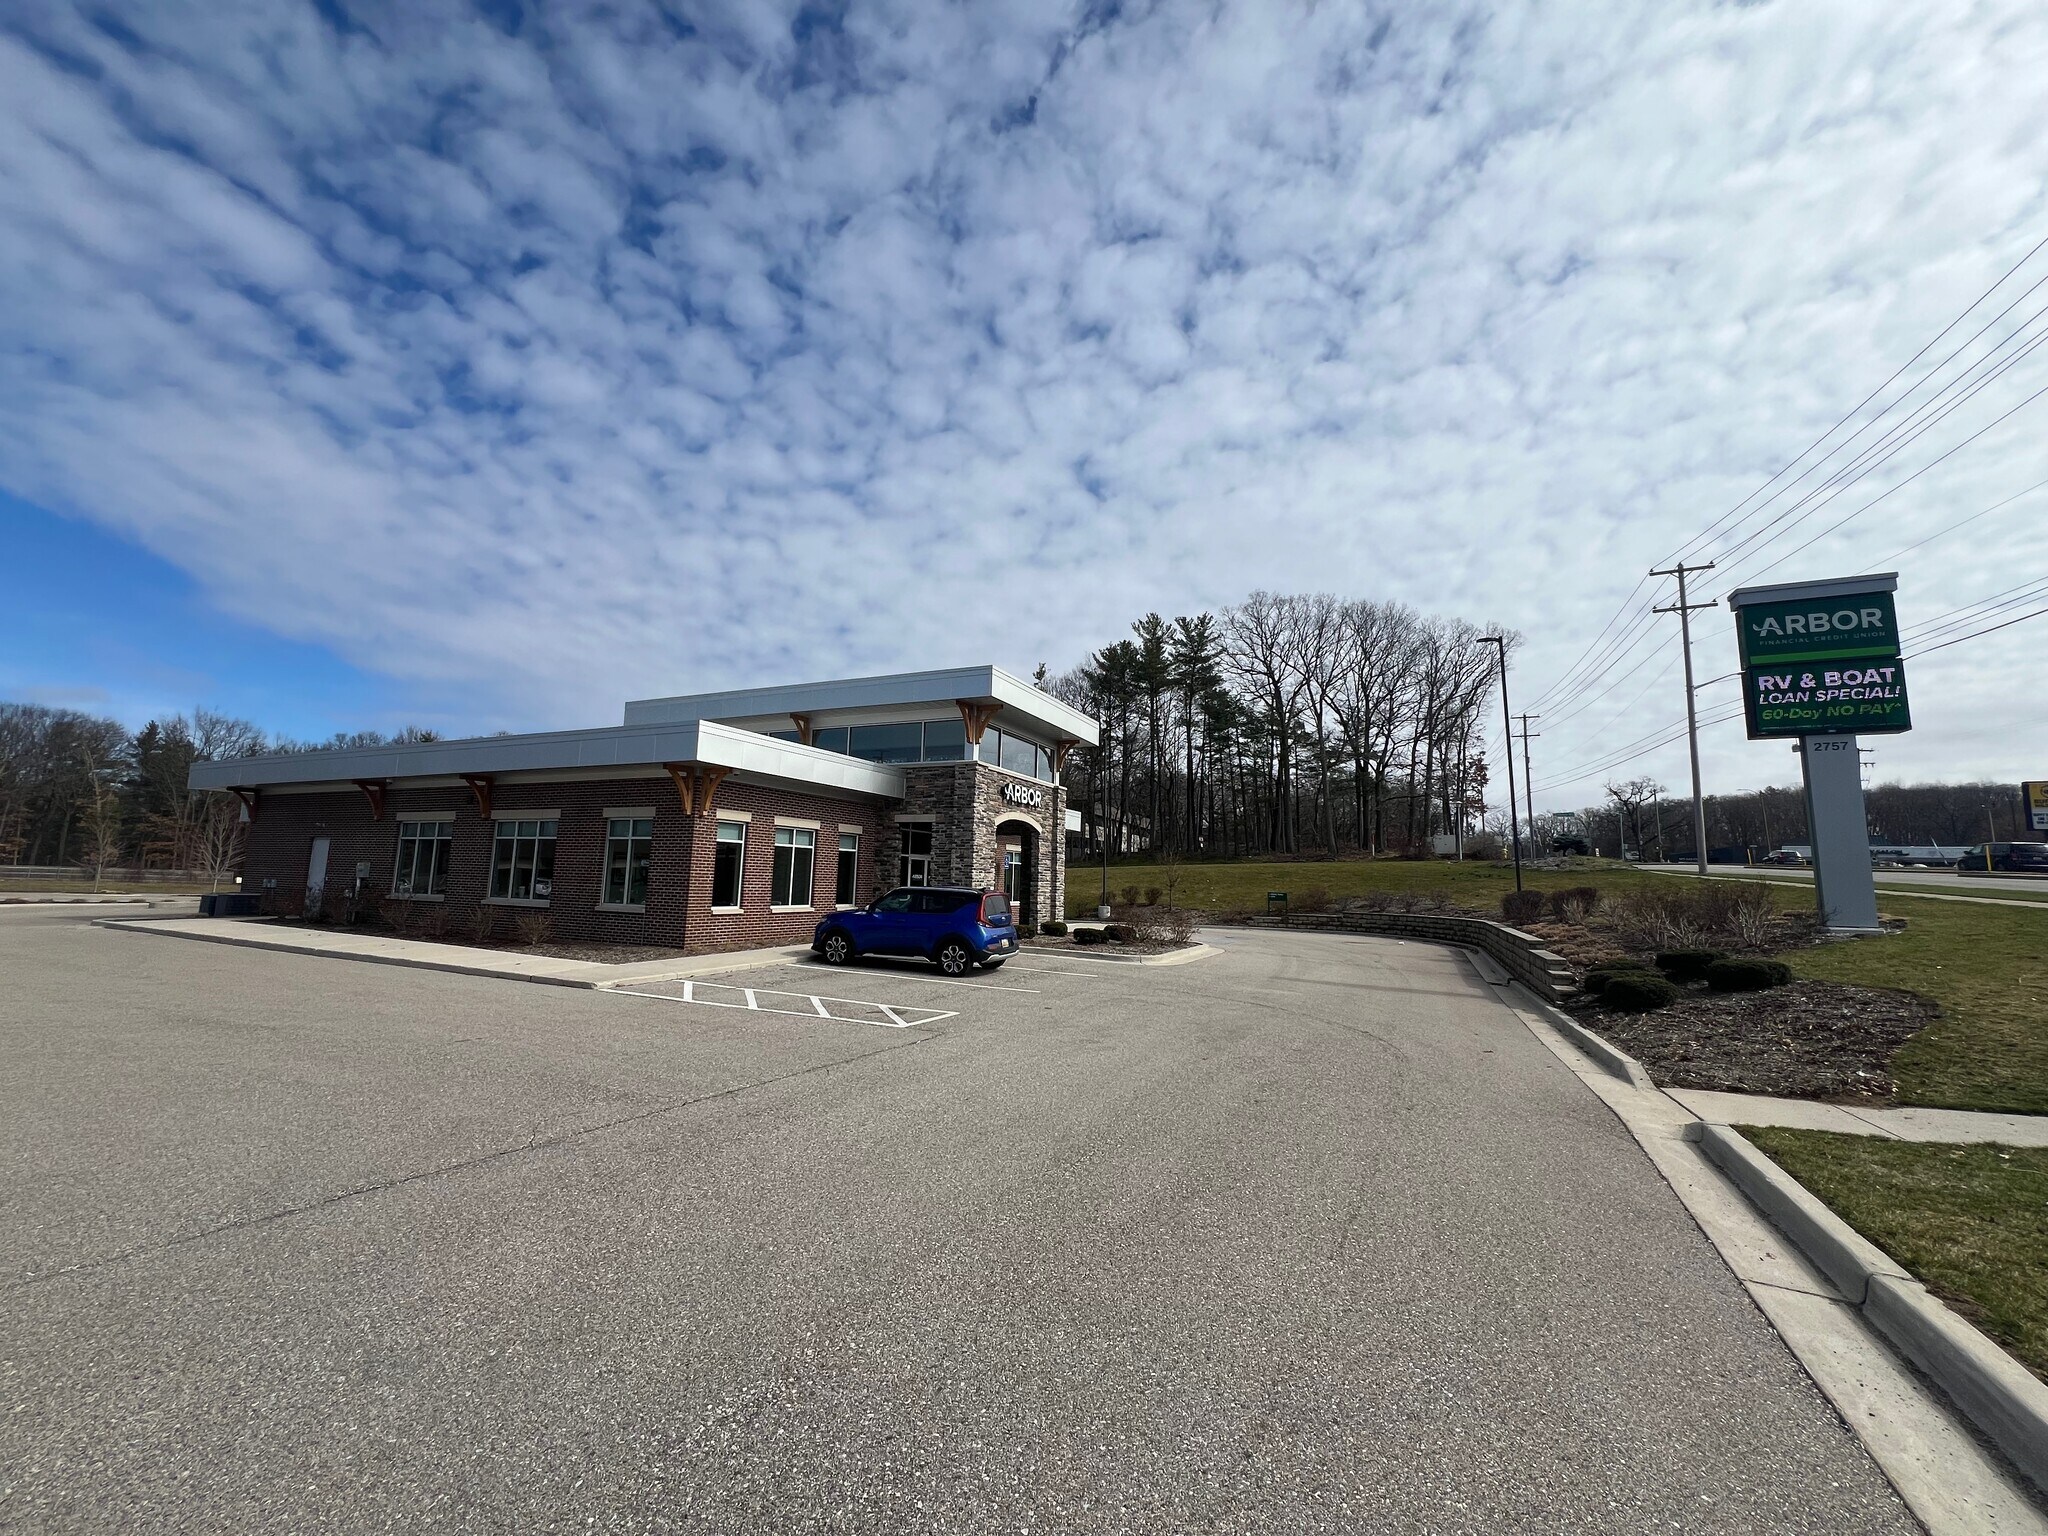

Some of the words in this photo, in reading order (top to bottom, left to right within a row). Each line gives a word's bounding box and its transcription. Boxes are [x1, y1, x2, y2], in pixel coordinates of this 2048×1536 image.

[1752, 608, 1883, 637] ARBOR
[1760, 637, 1810, 646] FINANCIAL
[1814, 634, 1849, 642] CREDIT
[1853, 631, 1886, 639] UNION
[1758, 674, 1793, 691] RV
[1800, 673, 1817, 688] &
[1824, 667, 1896, 686] BOAT
[1759, 691, 1809, 705] LOAN
[1815, 685, 1901, 702] SPECIAL!
[1827, 705, 1855, 717] NO
[1814, 741, 1849, 752] 2757
[1004, 782, 1042, 807] ARBOR
